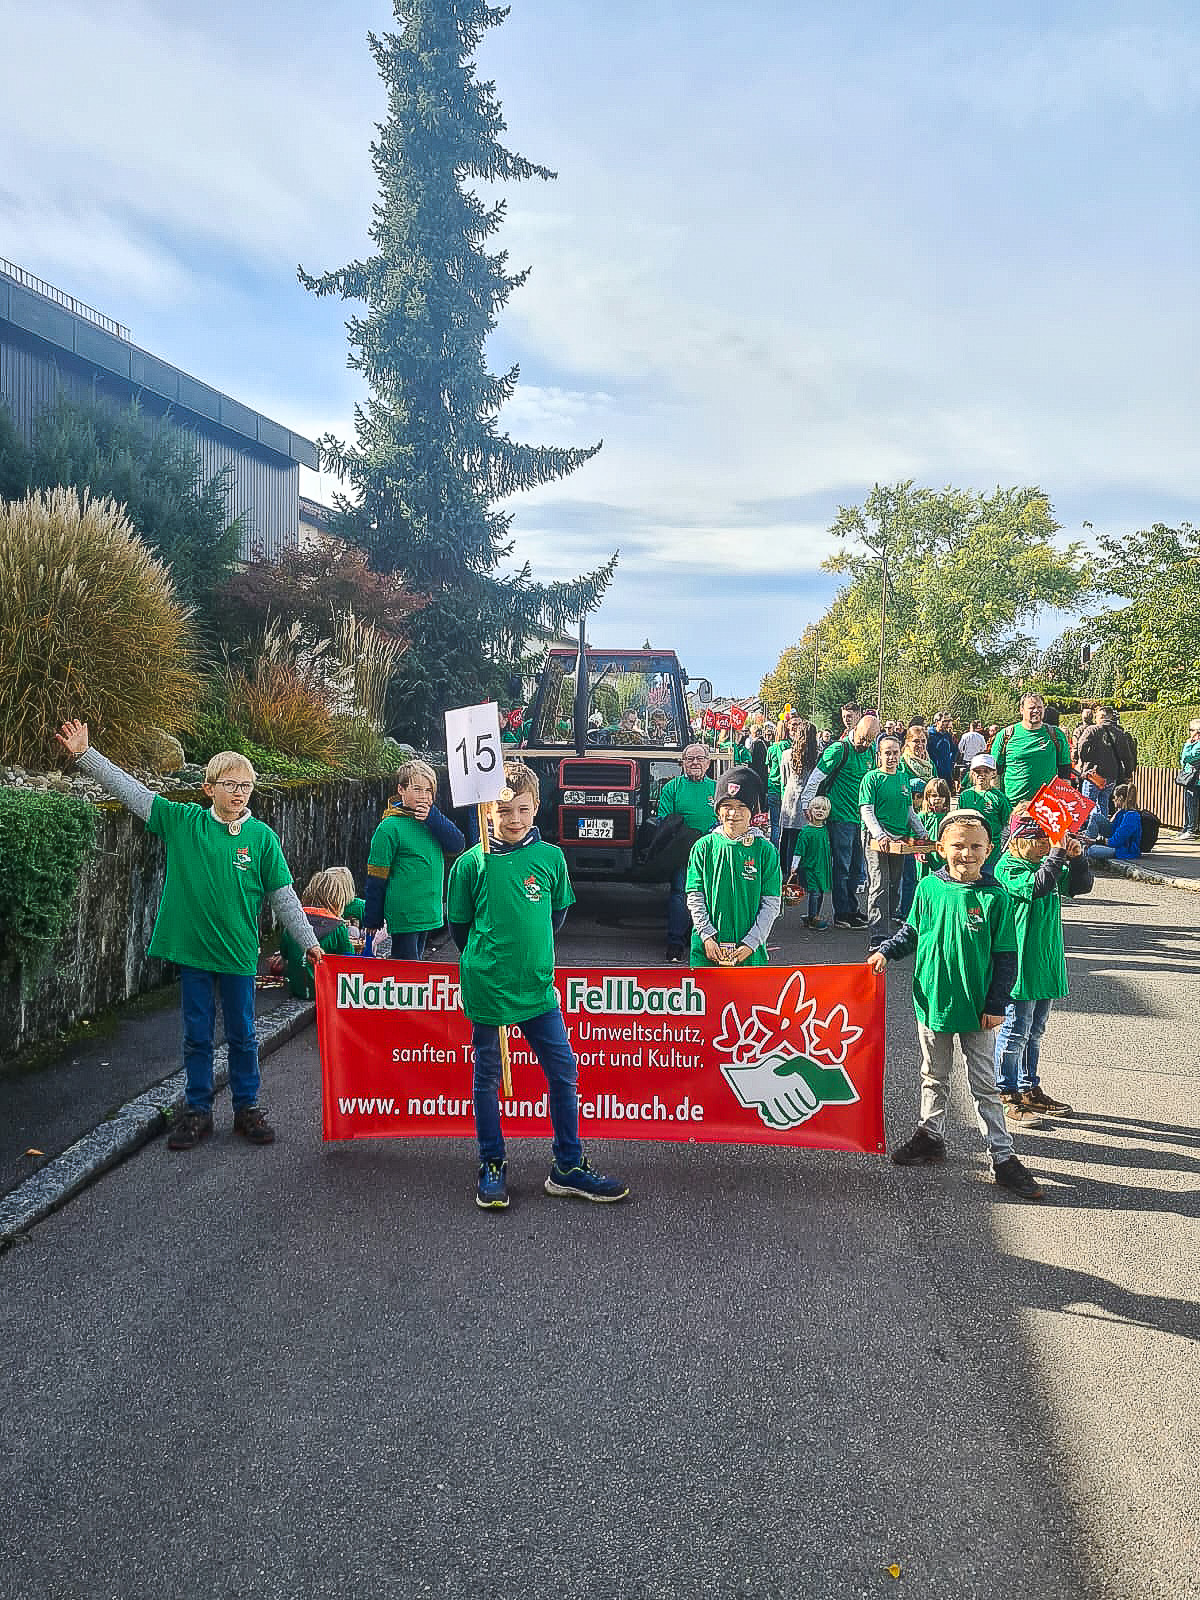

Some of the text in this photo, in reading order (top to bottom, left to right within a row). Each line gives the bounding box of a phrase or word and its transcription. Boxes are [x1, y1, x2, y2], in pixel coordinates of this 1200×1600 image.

[455, 733, 496, 776] 15
[337, 973, 706, 1016] NaturFr Fellbach
[578, 1021, 705, 1047] Umweltschutz,
[392, 1043, 456, 1063] sanften
[610, 1050, 642, 1068] und
[648, 1049, 704, 1069] Kultur.
[338, 1097, 400, 1116] www.
